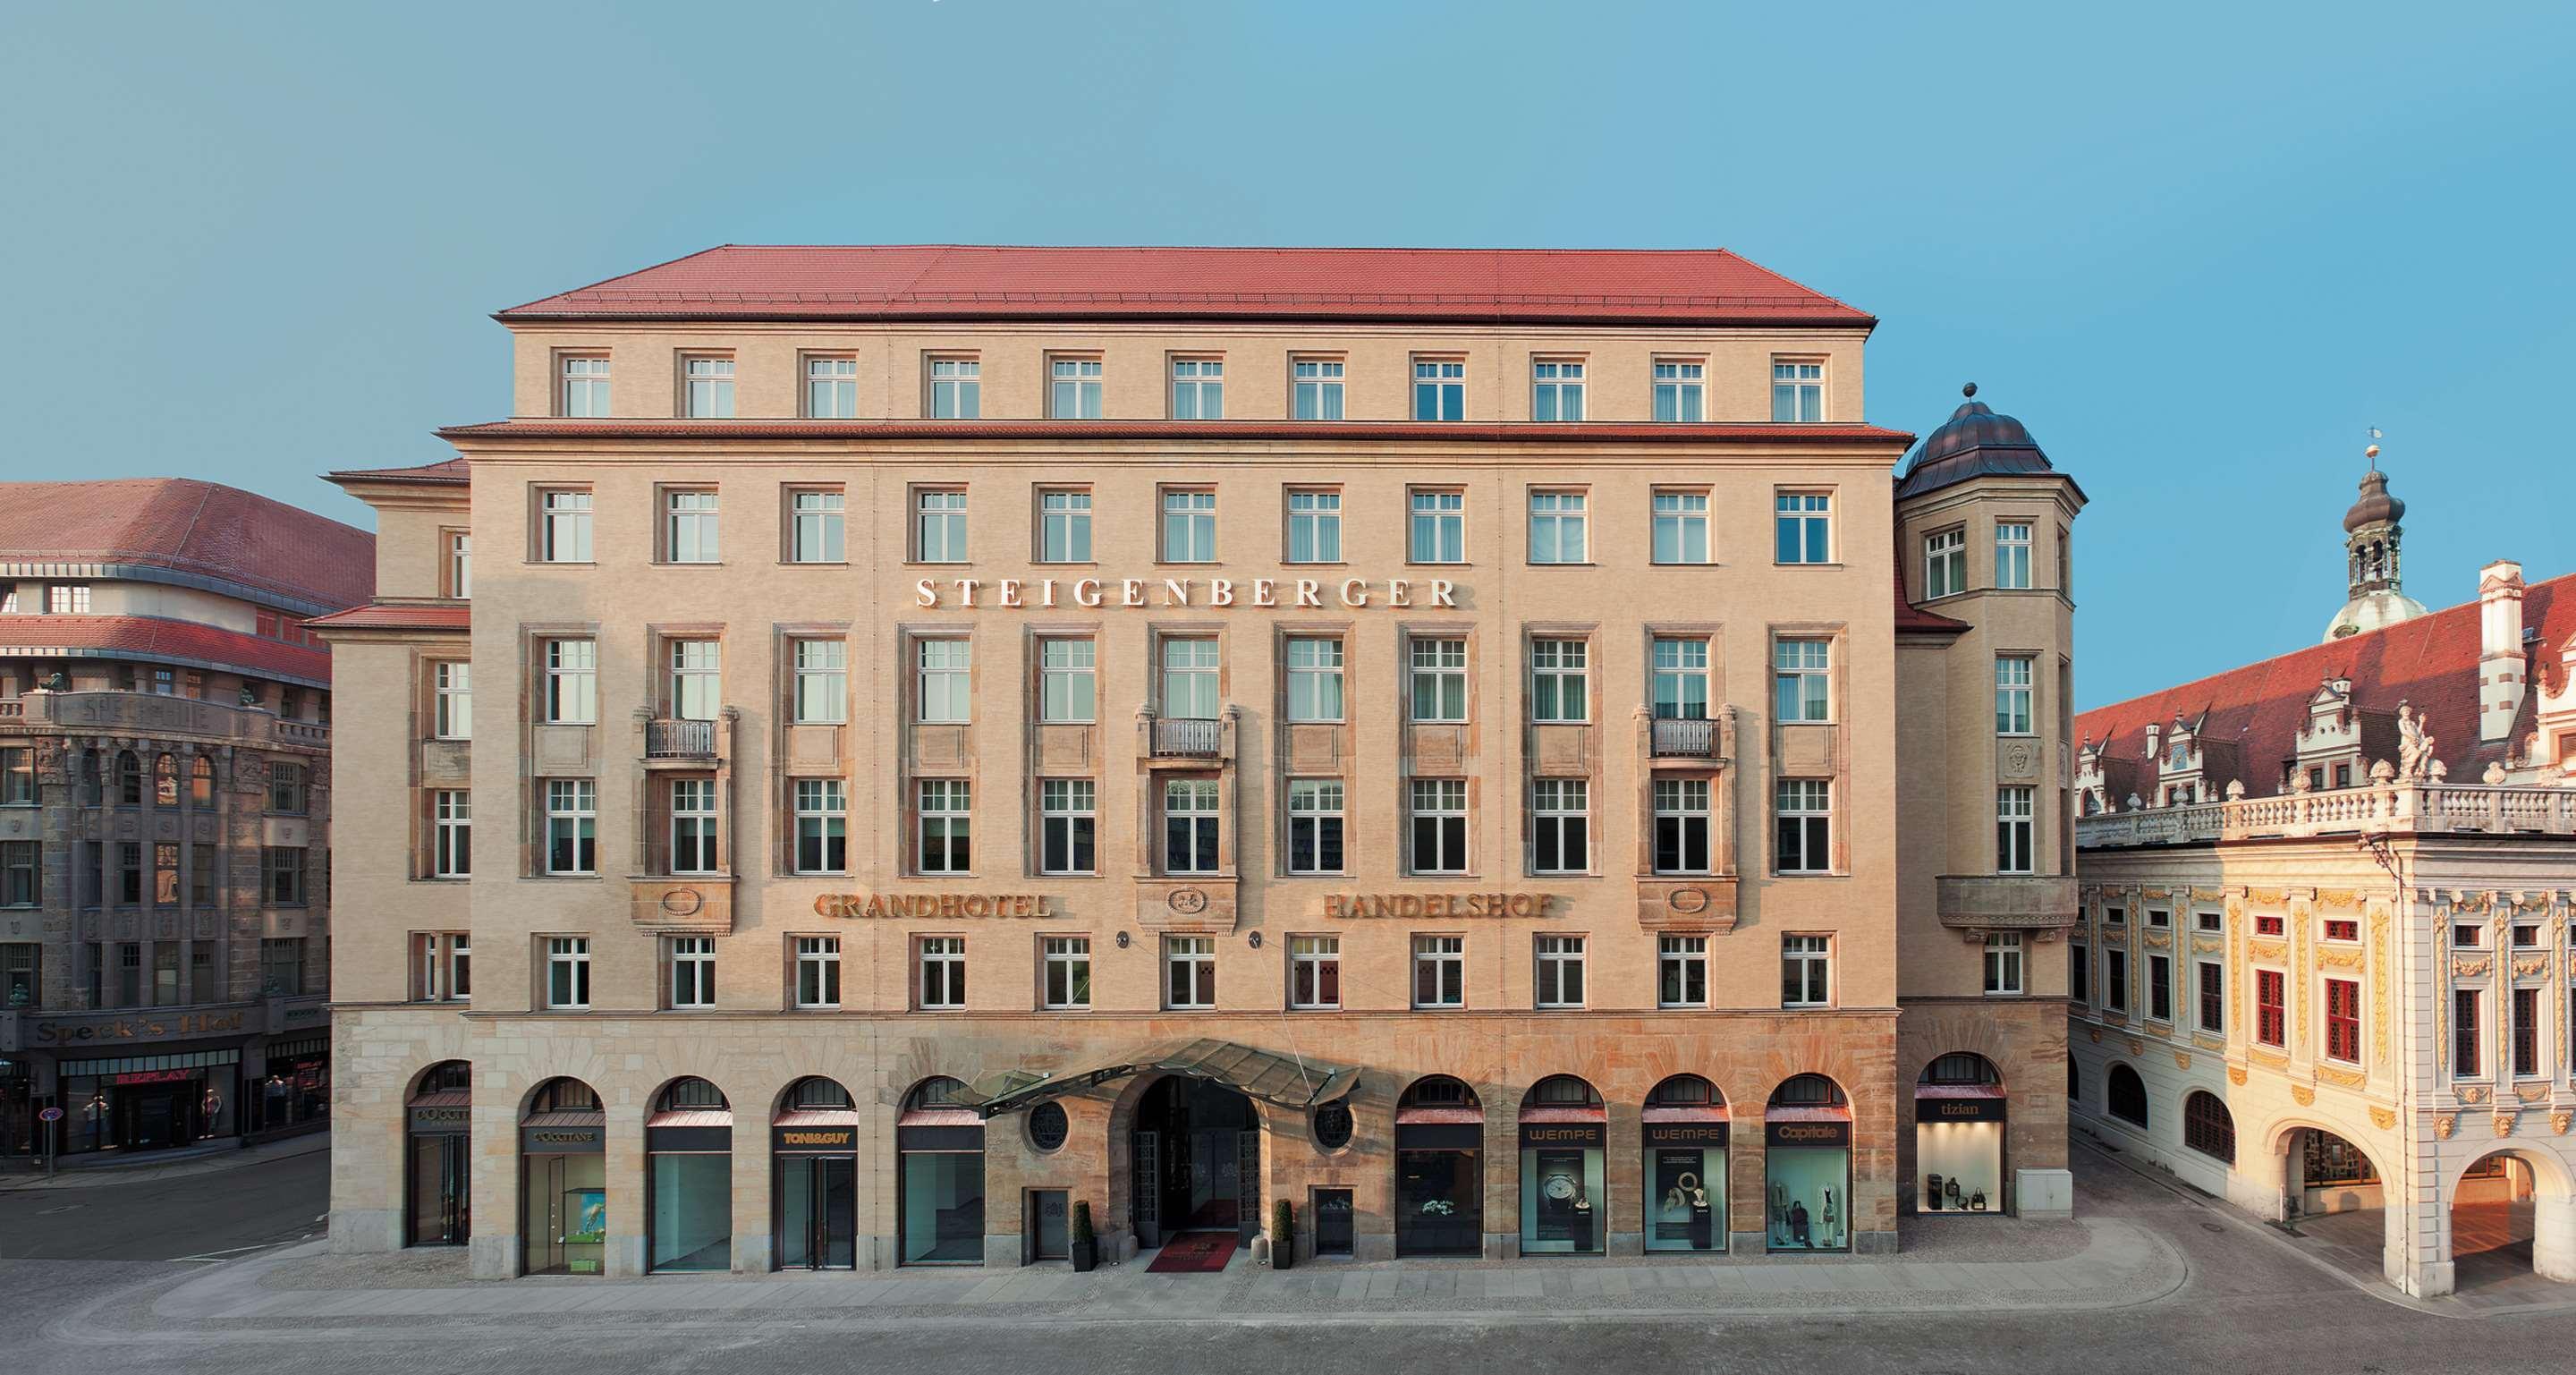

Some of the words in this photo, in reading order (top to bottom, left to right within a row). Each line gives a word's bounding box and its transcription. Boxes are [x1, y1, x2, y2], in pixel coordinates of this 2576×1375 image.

[915, 578, 1457, 608] STEIGENBERGER
[812, 894, 1053, 918] GRANDHOTEL
[1323, 893, 1555, 919] HANDELSHOF
[37, 1014, 165, 1045] Speck's
[179, 1010, 245, 1035] Hof
[116, 1069, 191, 1084] REPLAY
[1940, 1102, 1979, 1116] tizian
[783, 1132, 851, 1144] TONI&GUY
[1529, 1129, 1597, 1141] WEMPE
[1652, 1128, 1720, 1140] WEMPE
[1777, 1125, 1838, 1142] Capitale
